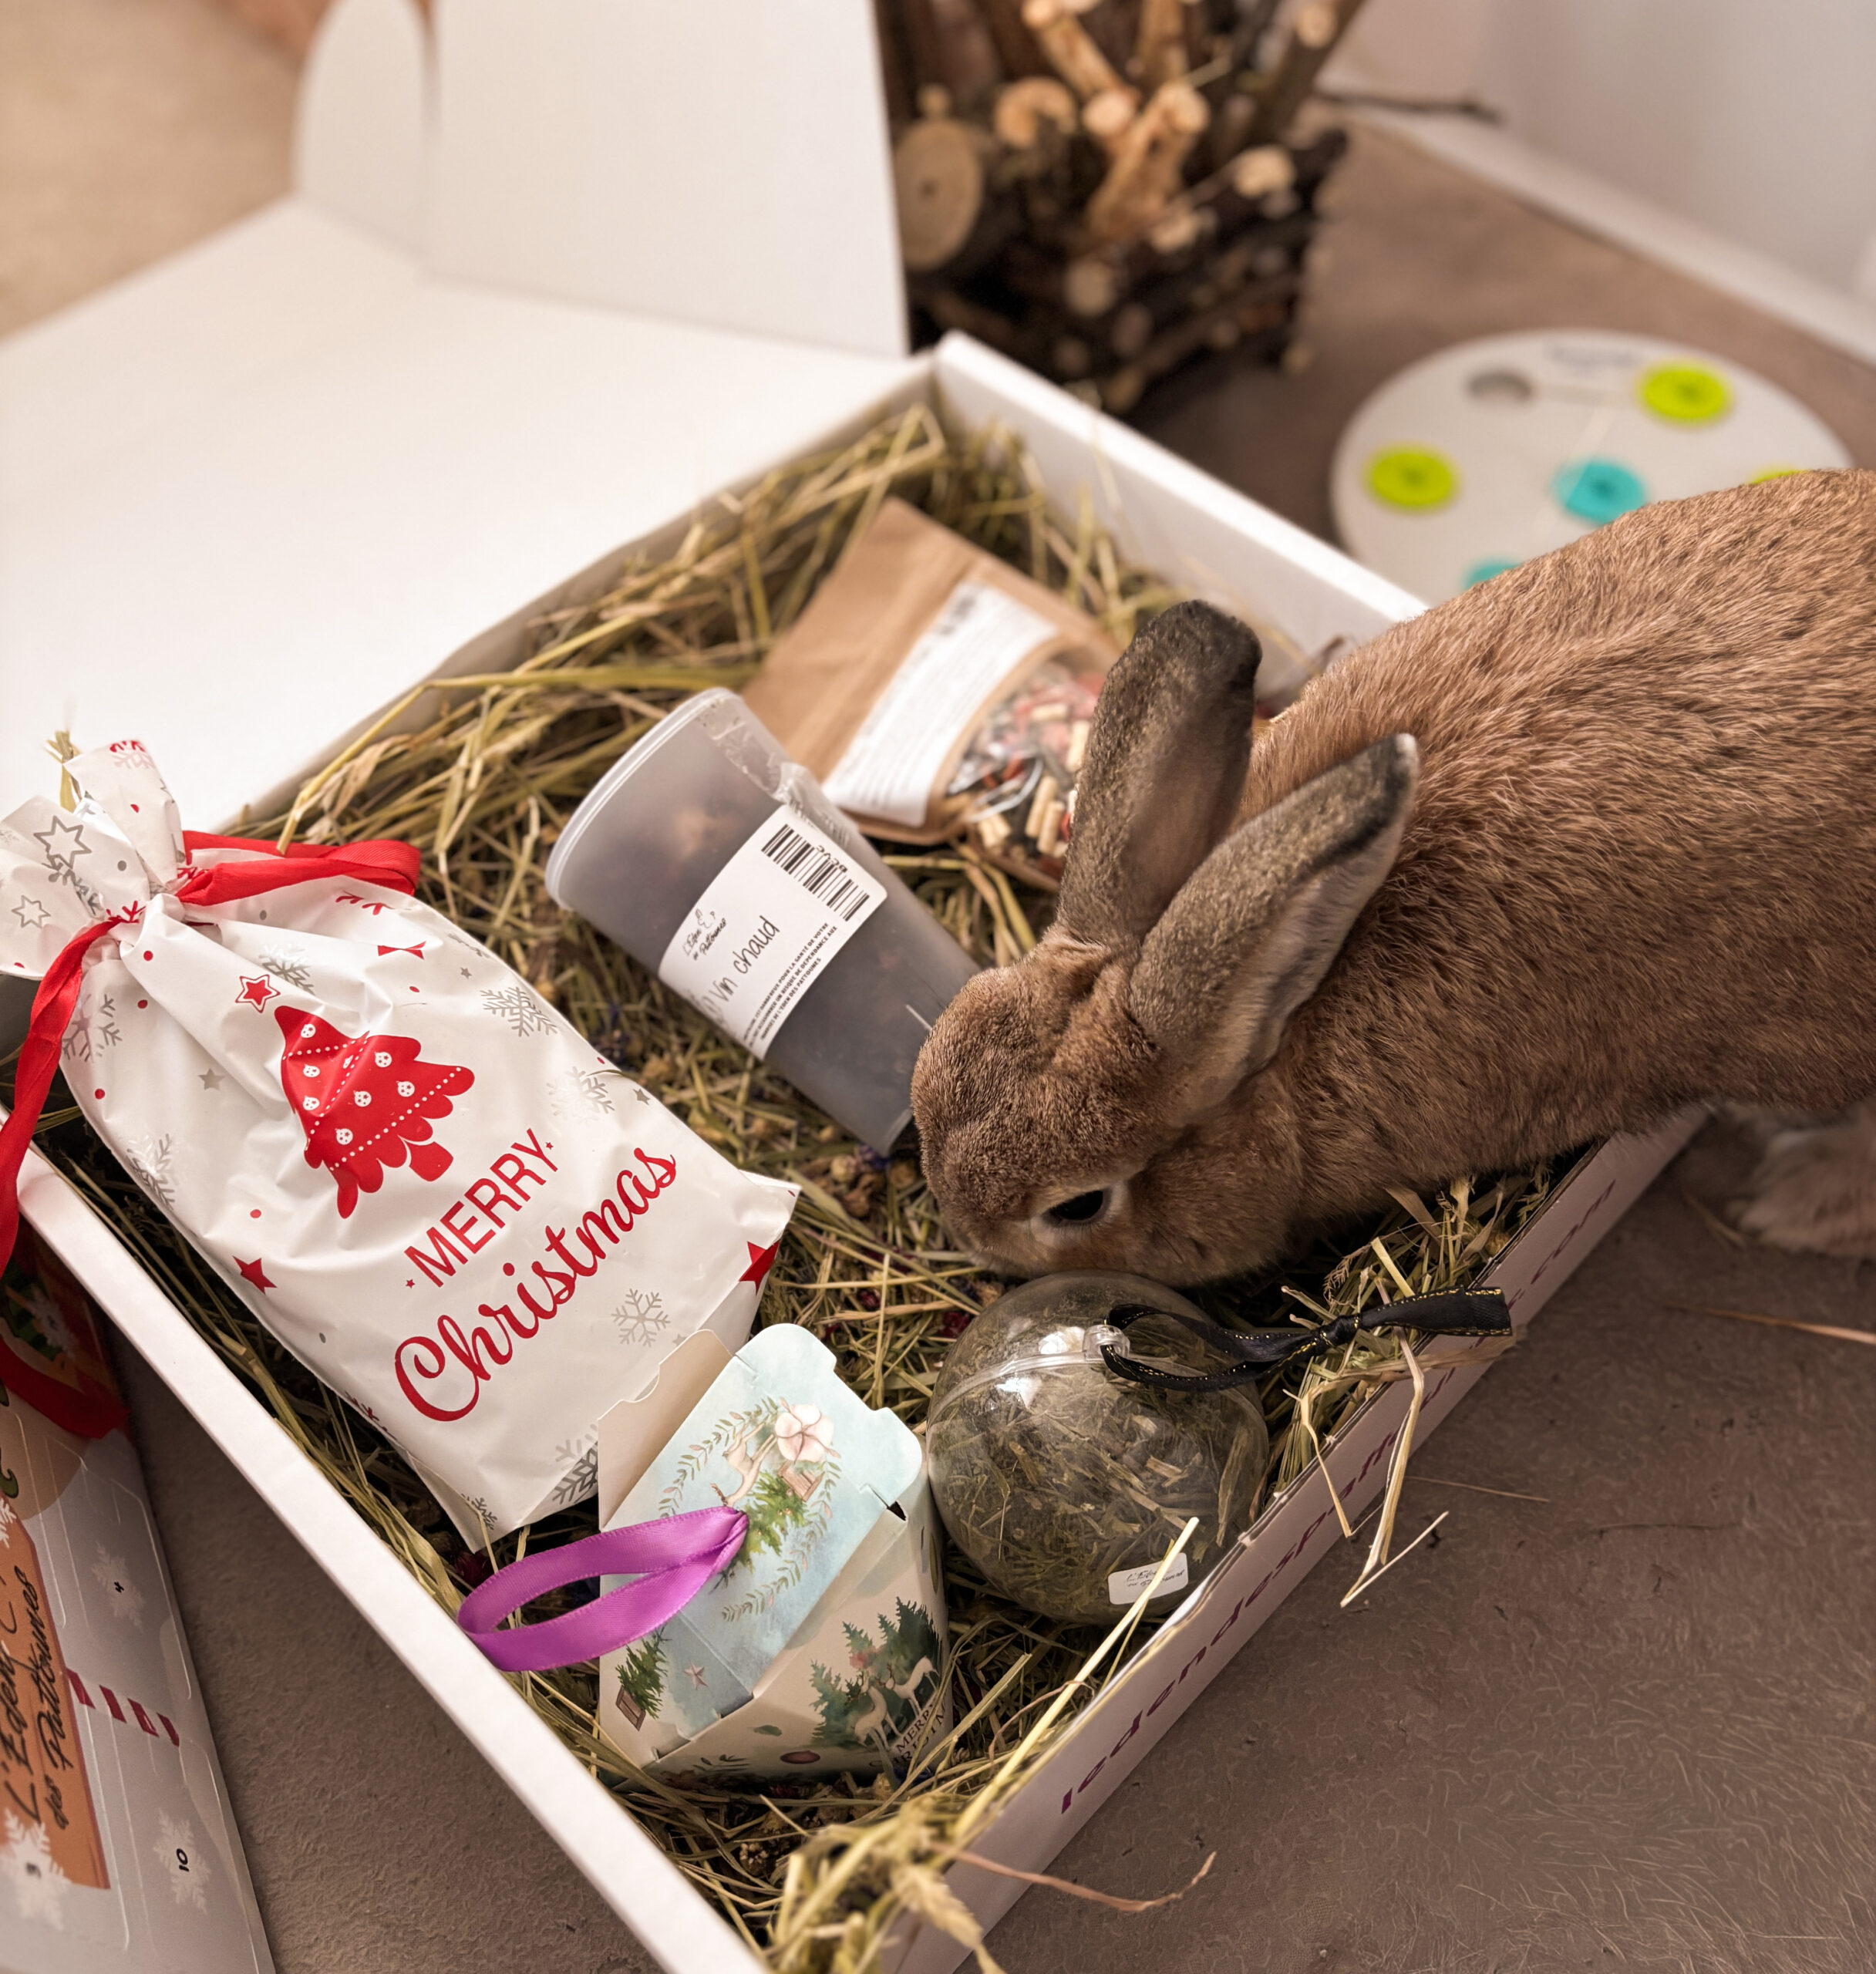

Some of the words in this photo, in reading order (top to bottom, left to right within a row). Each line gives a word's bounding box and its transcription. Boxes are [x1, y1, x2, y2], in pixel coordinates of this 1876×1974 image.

[733, 915, 780, 974] chaud
[777, 968, 790, 984] POUR
[807, 938, 815, 947] DE
[813, 921, 828, 940] VOTRE
[794, 968, 802, 976] DE
[827, 925, 837, 937] AUX
[788, 985, 798, 997] DES
[796, 956, 821, 987] PATTOUNES
[404, 1128, 558, 1287] MERRY
[395, 1147, 676, 1422] Christmas
[14, 1565, 74, 1770] Pattounes
[176, 1848, 190, 1872] 10
